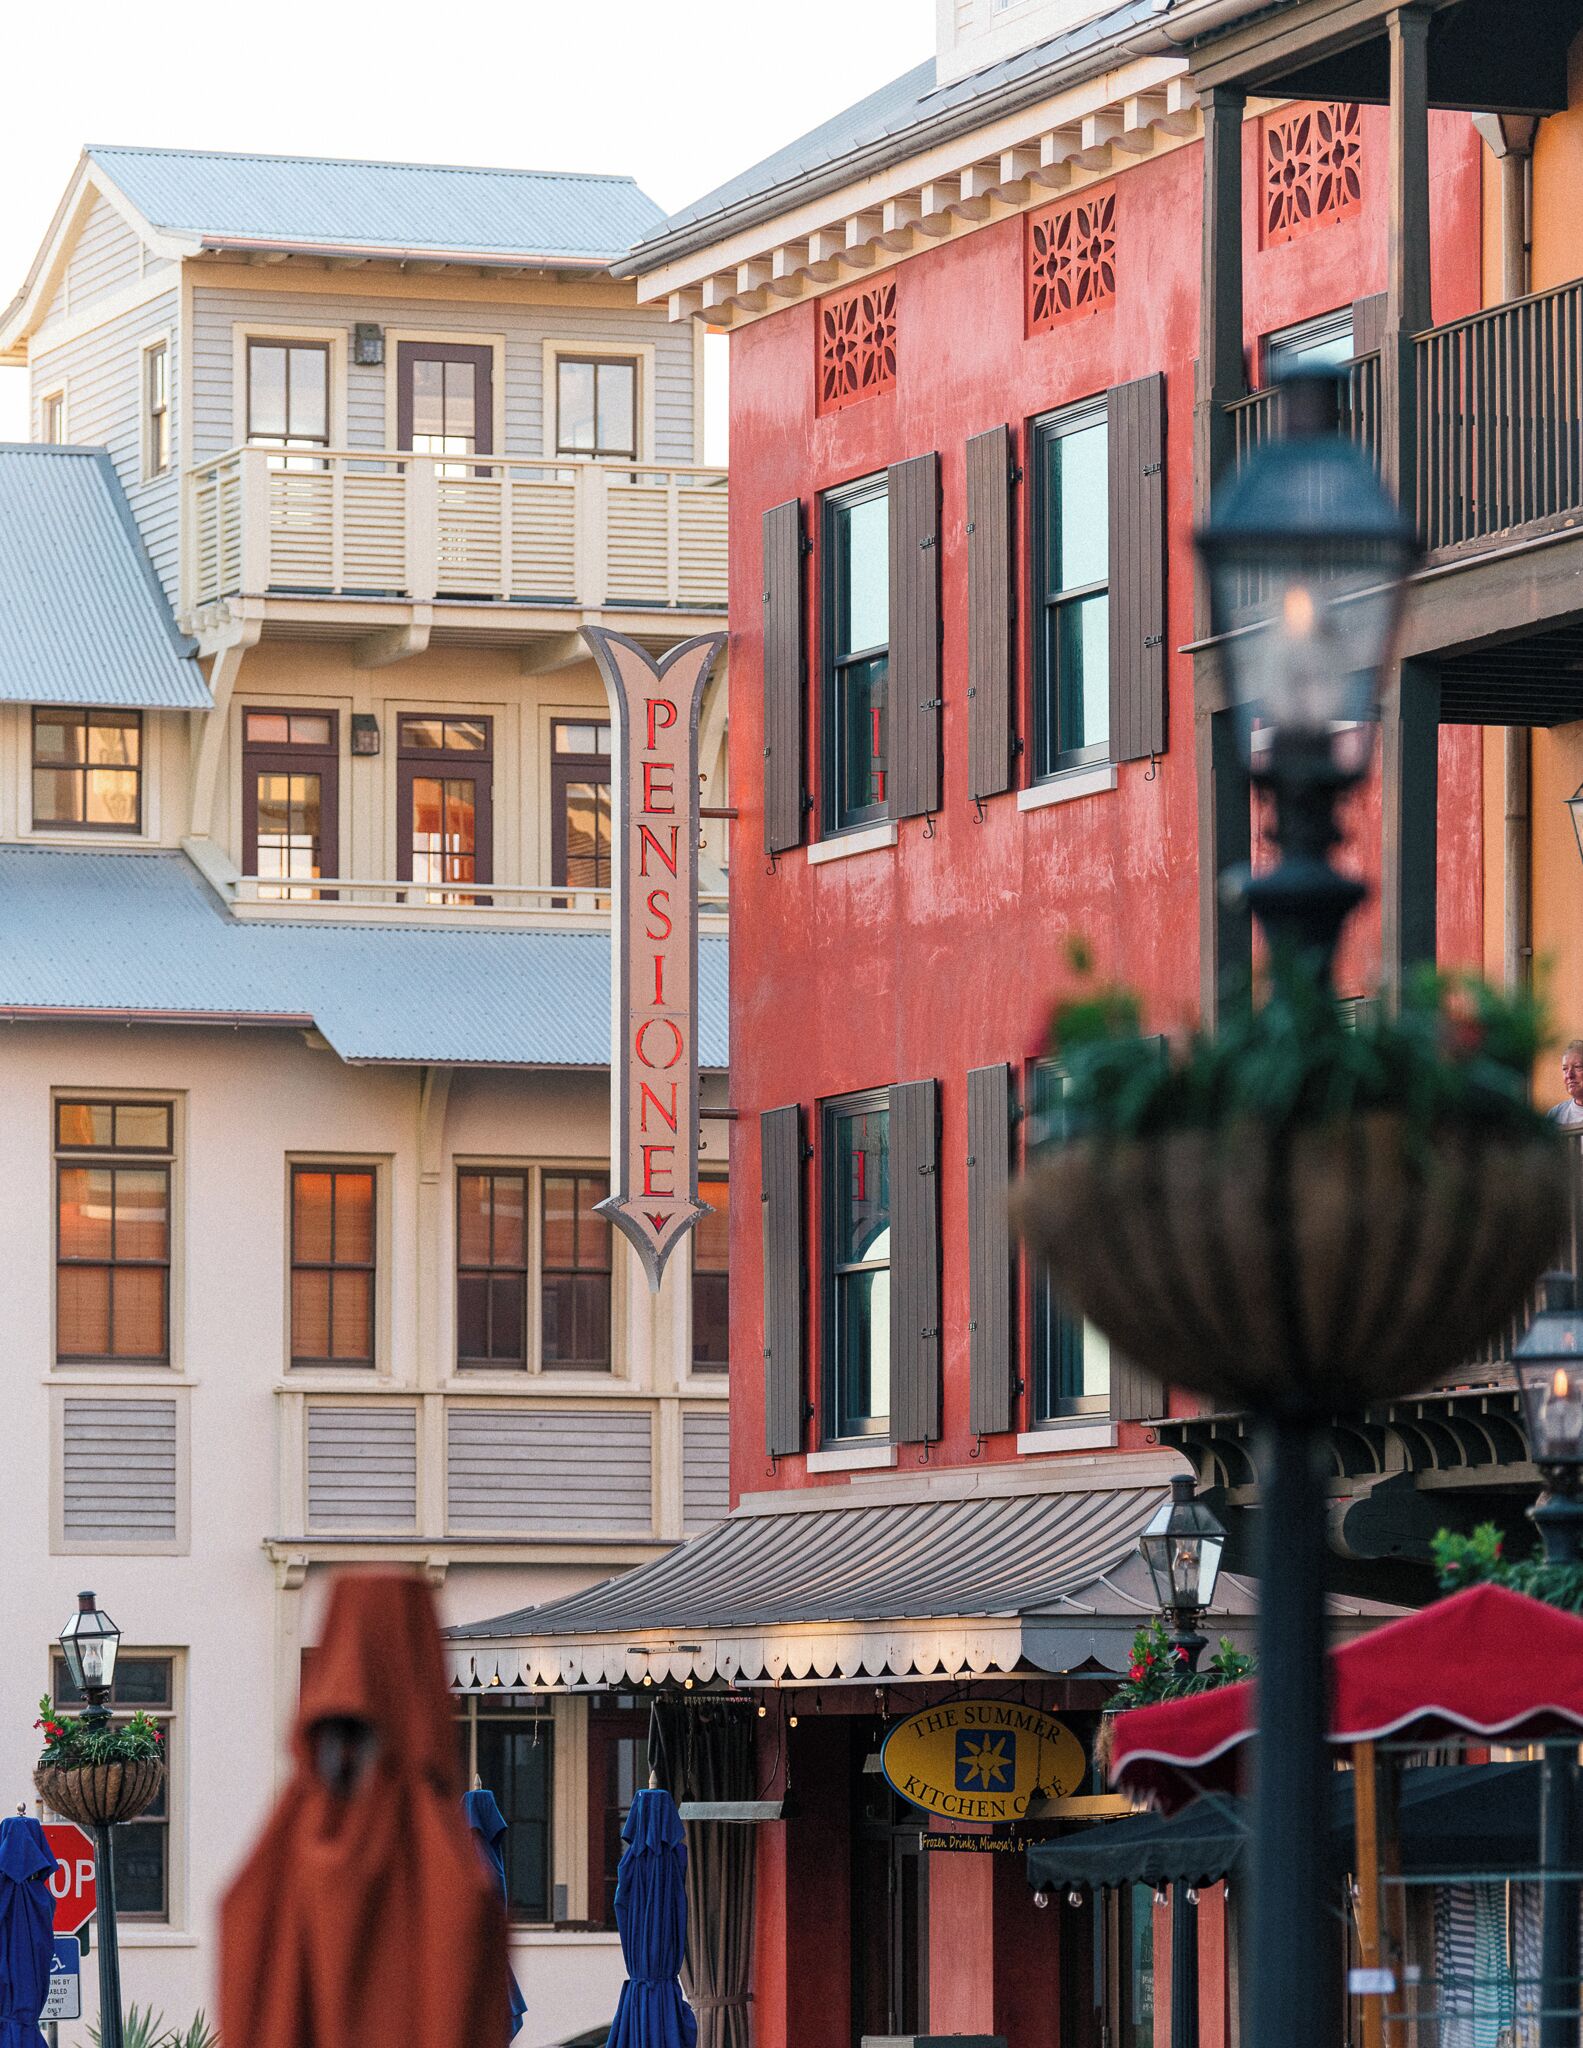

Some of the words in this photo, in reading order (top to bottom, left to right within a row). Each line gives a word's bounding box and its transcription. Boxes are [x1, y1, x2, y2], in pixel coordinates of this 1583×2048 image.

[636, 698, 684, 1198] PENSIONE
[908, 1709, 958, 1739] THE
[964, 1706, 1062, 1744] SUMMER
[902, 1774, 1006, 1817] KITCHEN
[1013, 1775, 1068, 1813] CFÉ
[922, 1834, 947, 1848] Frozen
[949, 1835, 978, 1852] Drinks,
[1018, 1837, 1024, 1851] &
[49, 1858, 96, 1898] OP
